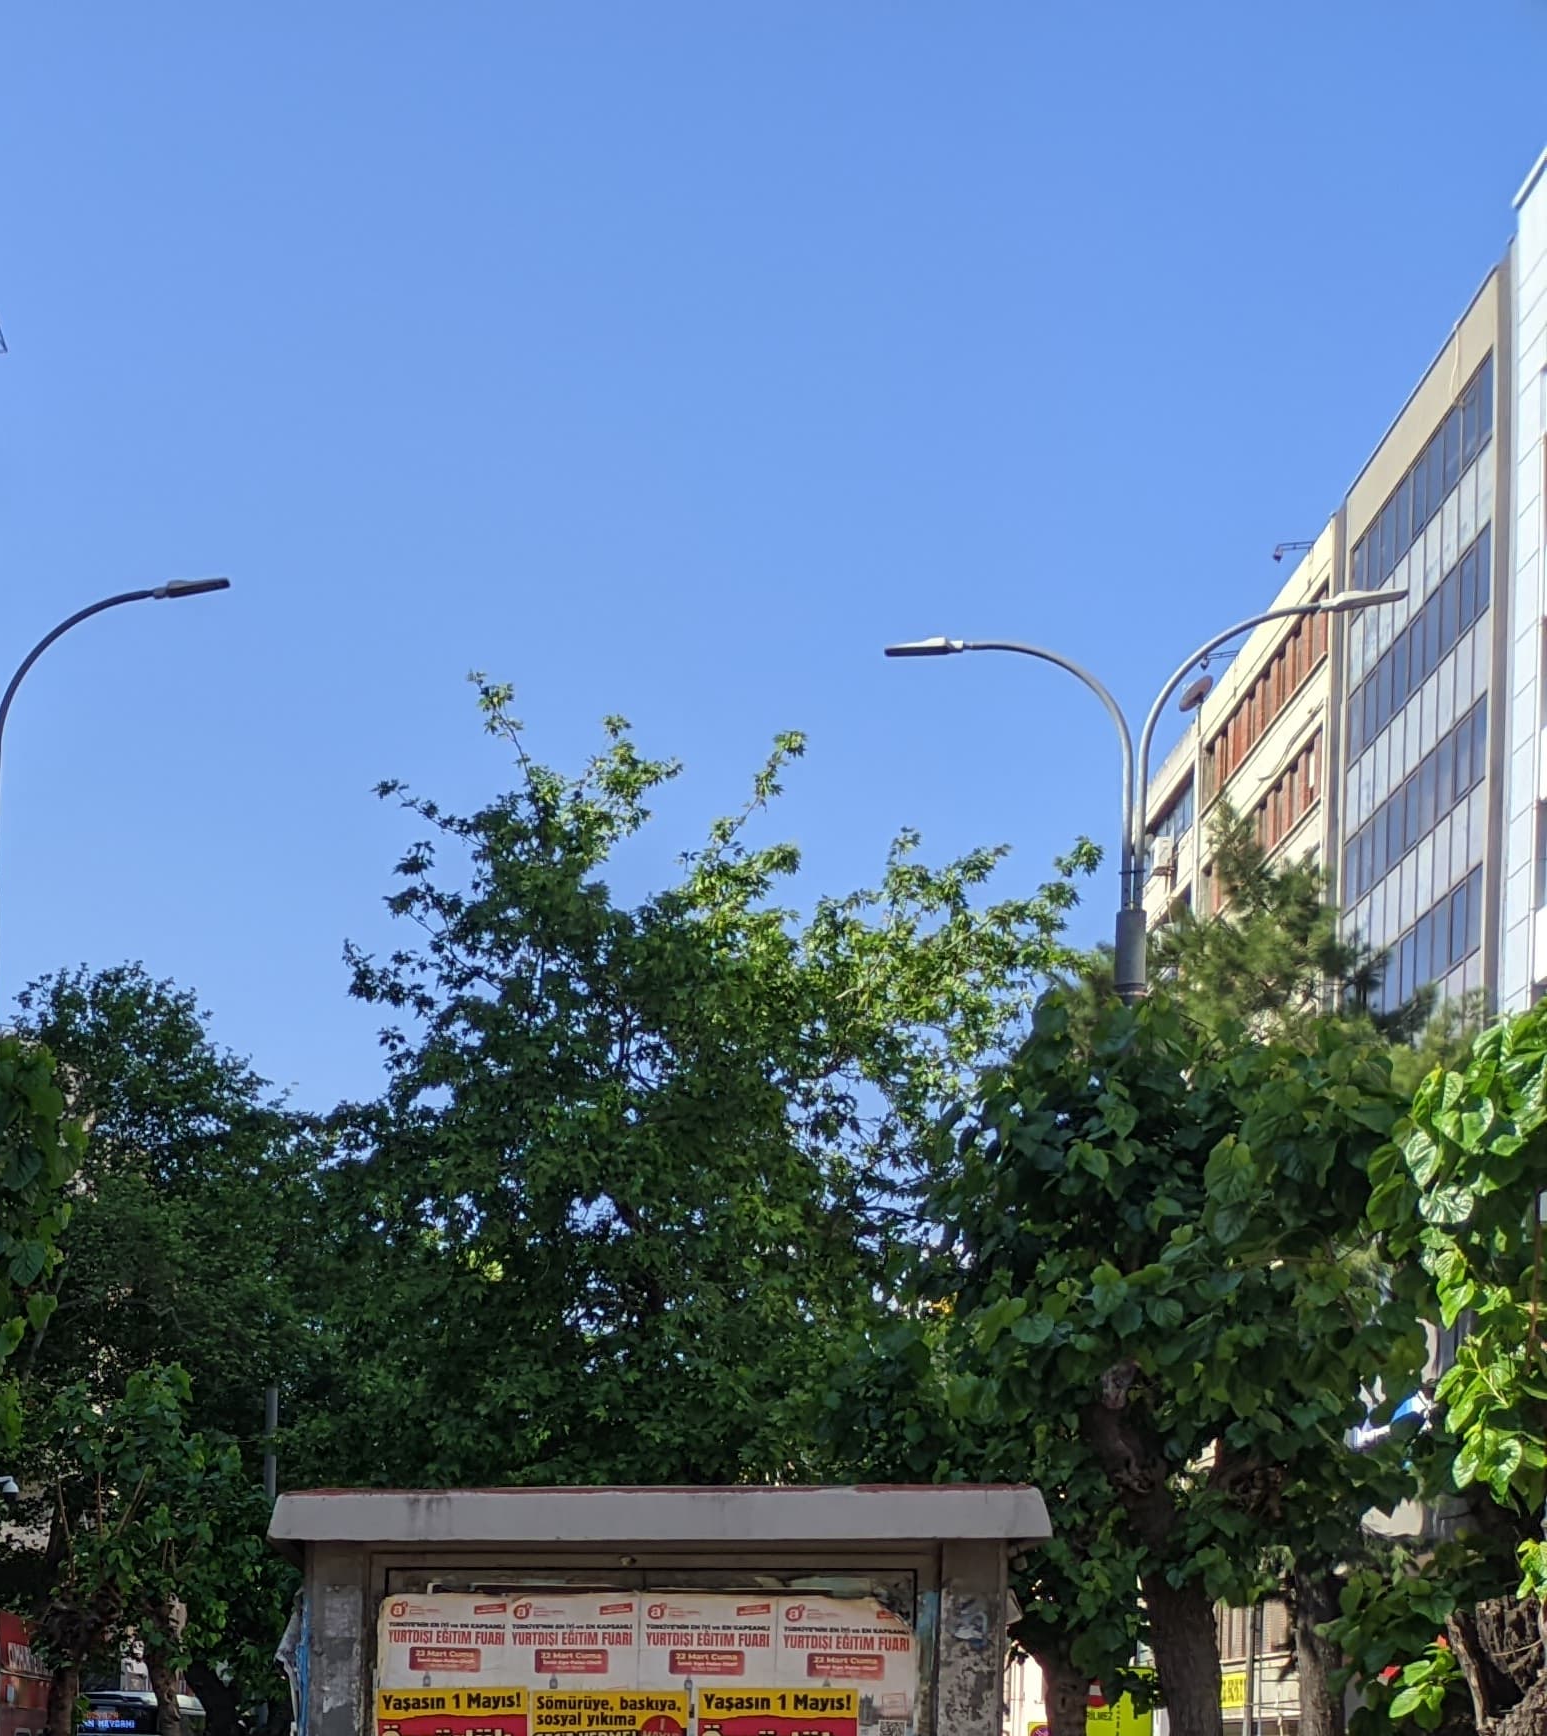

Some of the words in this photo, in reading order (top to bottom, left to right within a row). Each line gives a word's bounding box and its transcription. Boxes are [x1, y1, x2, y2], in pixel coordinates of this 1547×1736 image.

[436, 1629, 471, 1645] EĞİTİM
[475, 1631, 505, 1646] FUARI
[561, 1629, 598, 1646] EĞİTİM
[602, 1631, 632, 1646] FUARI
[697, 1630, 734, 1647] EĞİTİM
[738, 1632, 769, 1647] FUARI
[836, 1632, 874, 1650] EĞİTİM
[878, 1635, 910, 1652] FUARI
[688, 1653, 709, 1661] Mart
[826, 1656, 847, 1664] Mart
[849, 1657, 877, 1665] Cuma
[382, 1693, 445, 1712] Yaşasın
[452, 1694, 460, 1709] 1
[467, 1691, 521, 1711] Mayıs!
[537, 1695, 614, 1712] Sömürüye,
[620, 1697, 681, 1712] baskıya,
[703, 1693, 771, 1714] Yaşasın
[777, 1695, 787, 1710] 1
[793, 1694, 851, 1711] Mayıs!
[536, 1712, 582, 1726] sosyal
[587, 1714, 636, 1727] yıkıma
